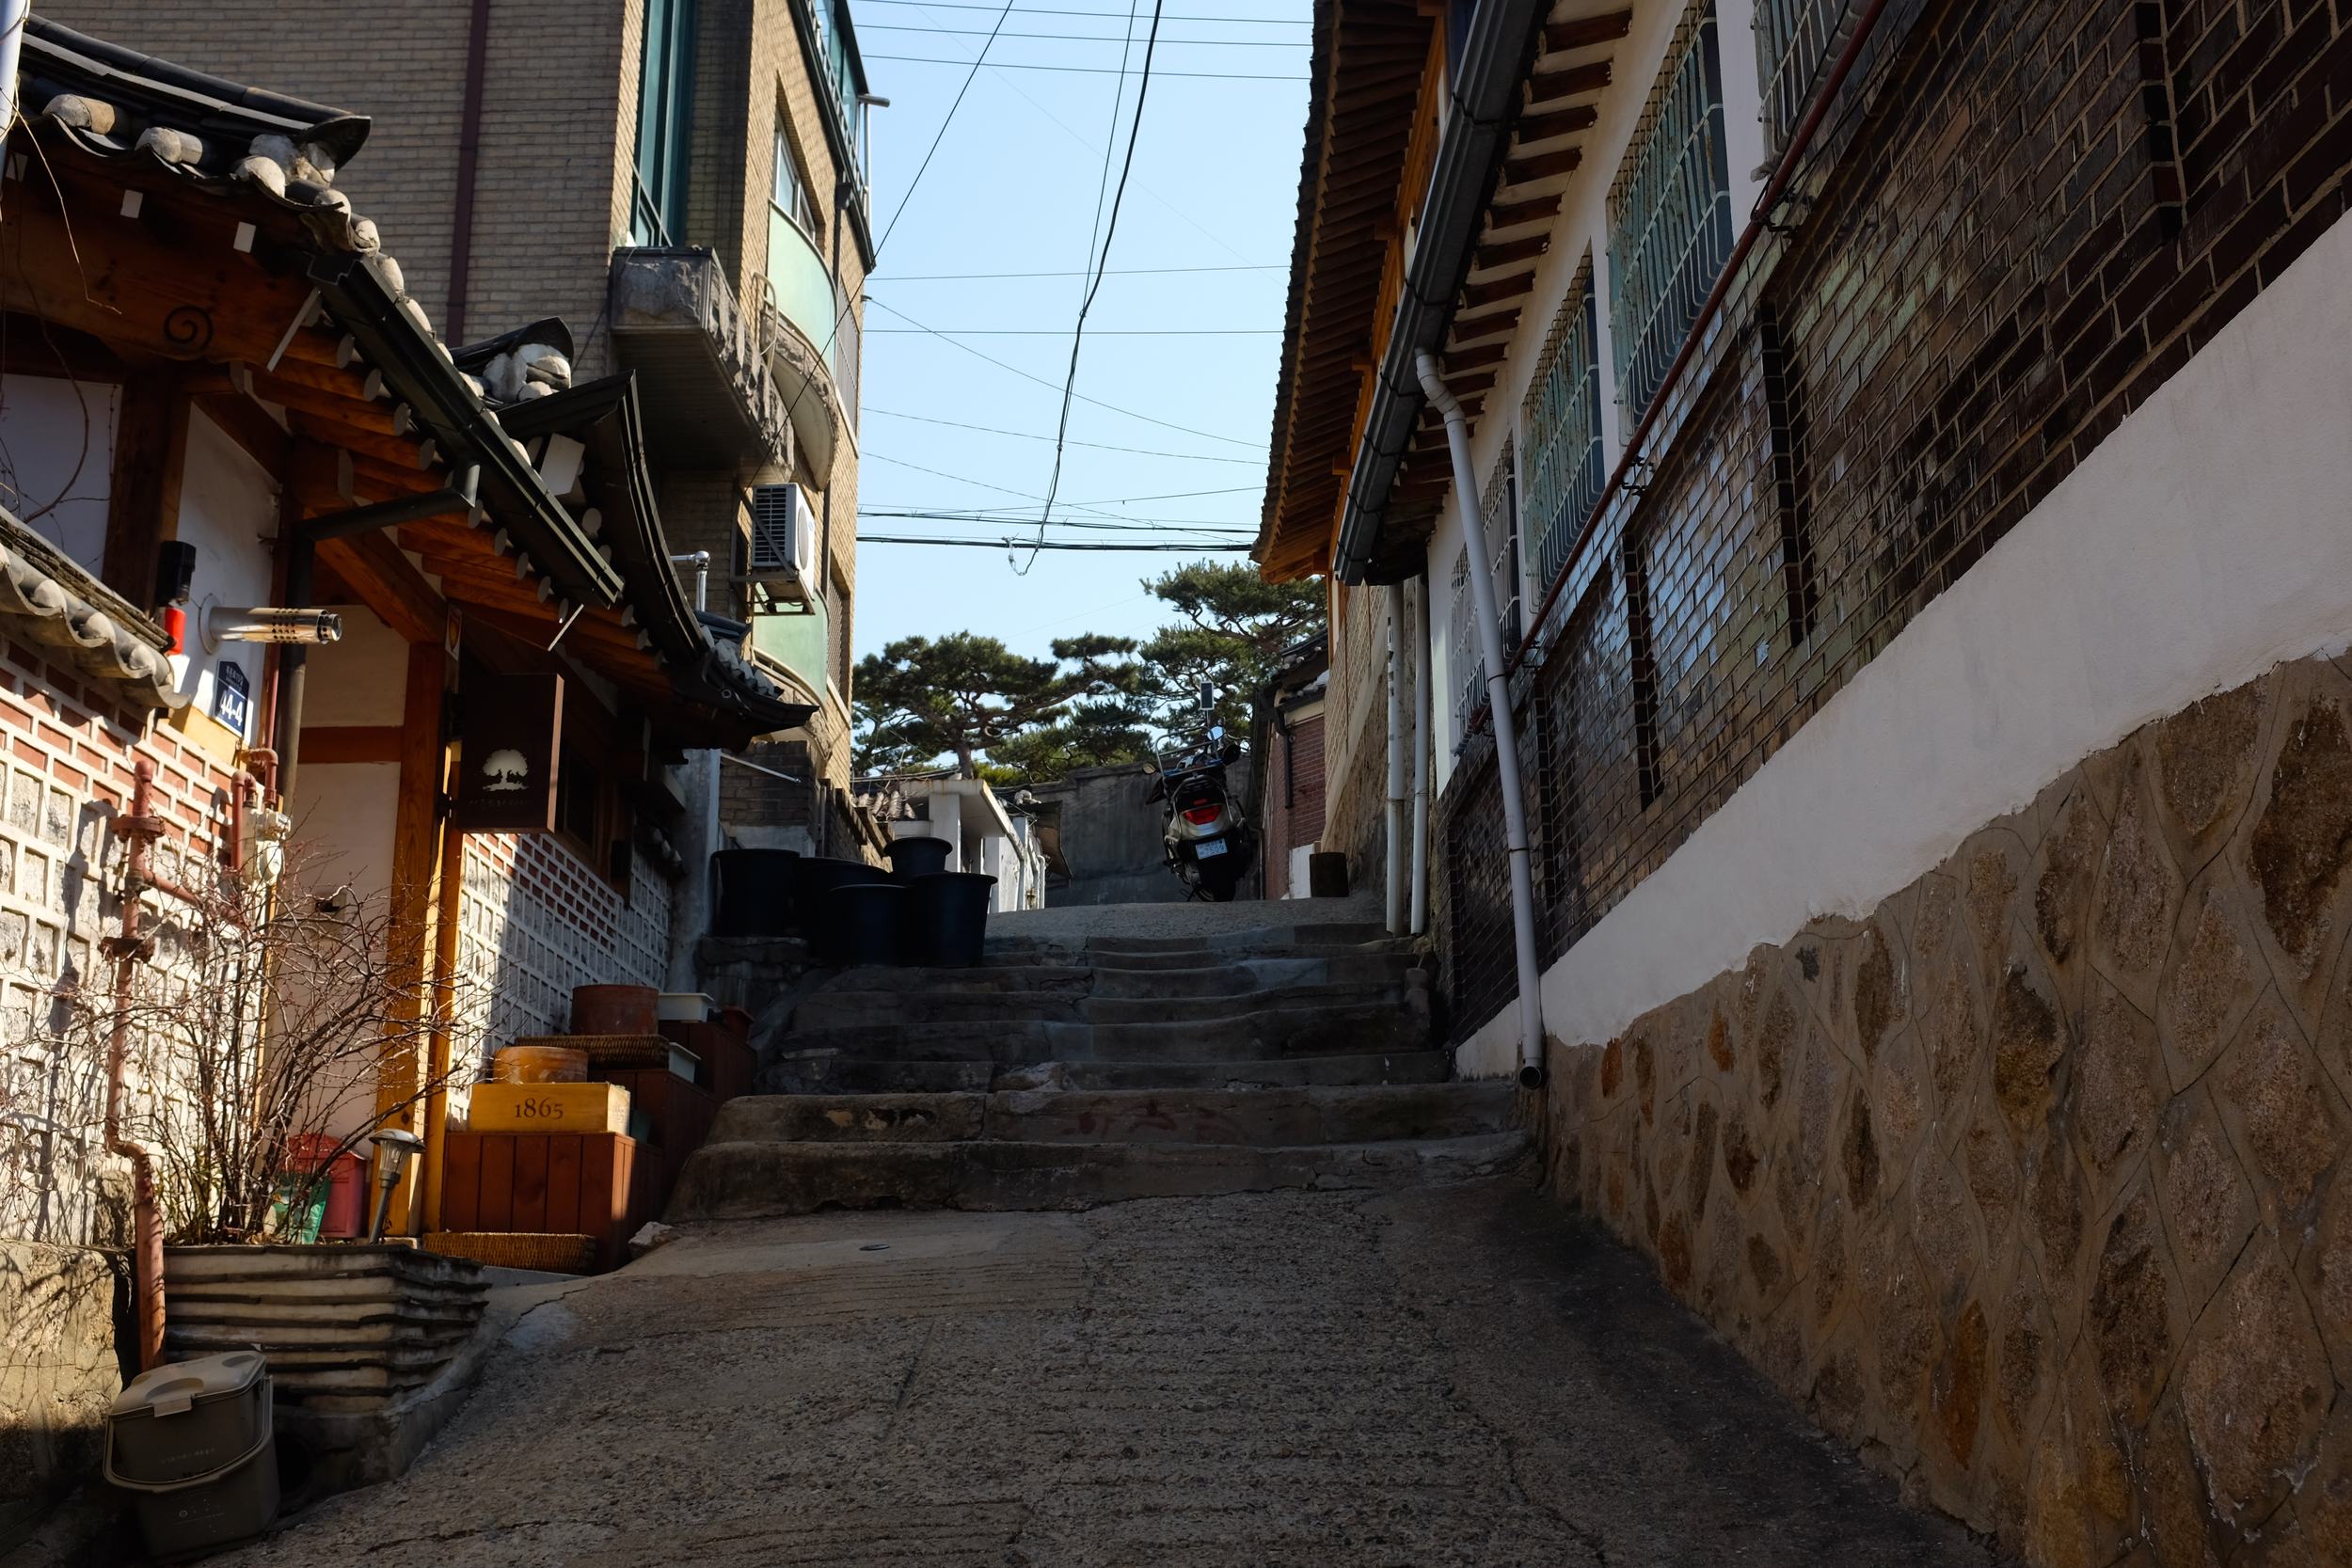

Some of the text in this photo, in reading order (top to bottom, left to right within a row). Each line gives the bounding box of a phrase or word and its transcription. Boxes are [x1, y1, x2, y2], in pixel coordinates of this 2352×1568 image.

[219, 689, 244, 727] 44-4
[1204, 845, 1225, 855] 7509
[515, 1097, 564, 1119] 1865
